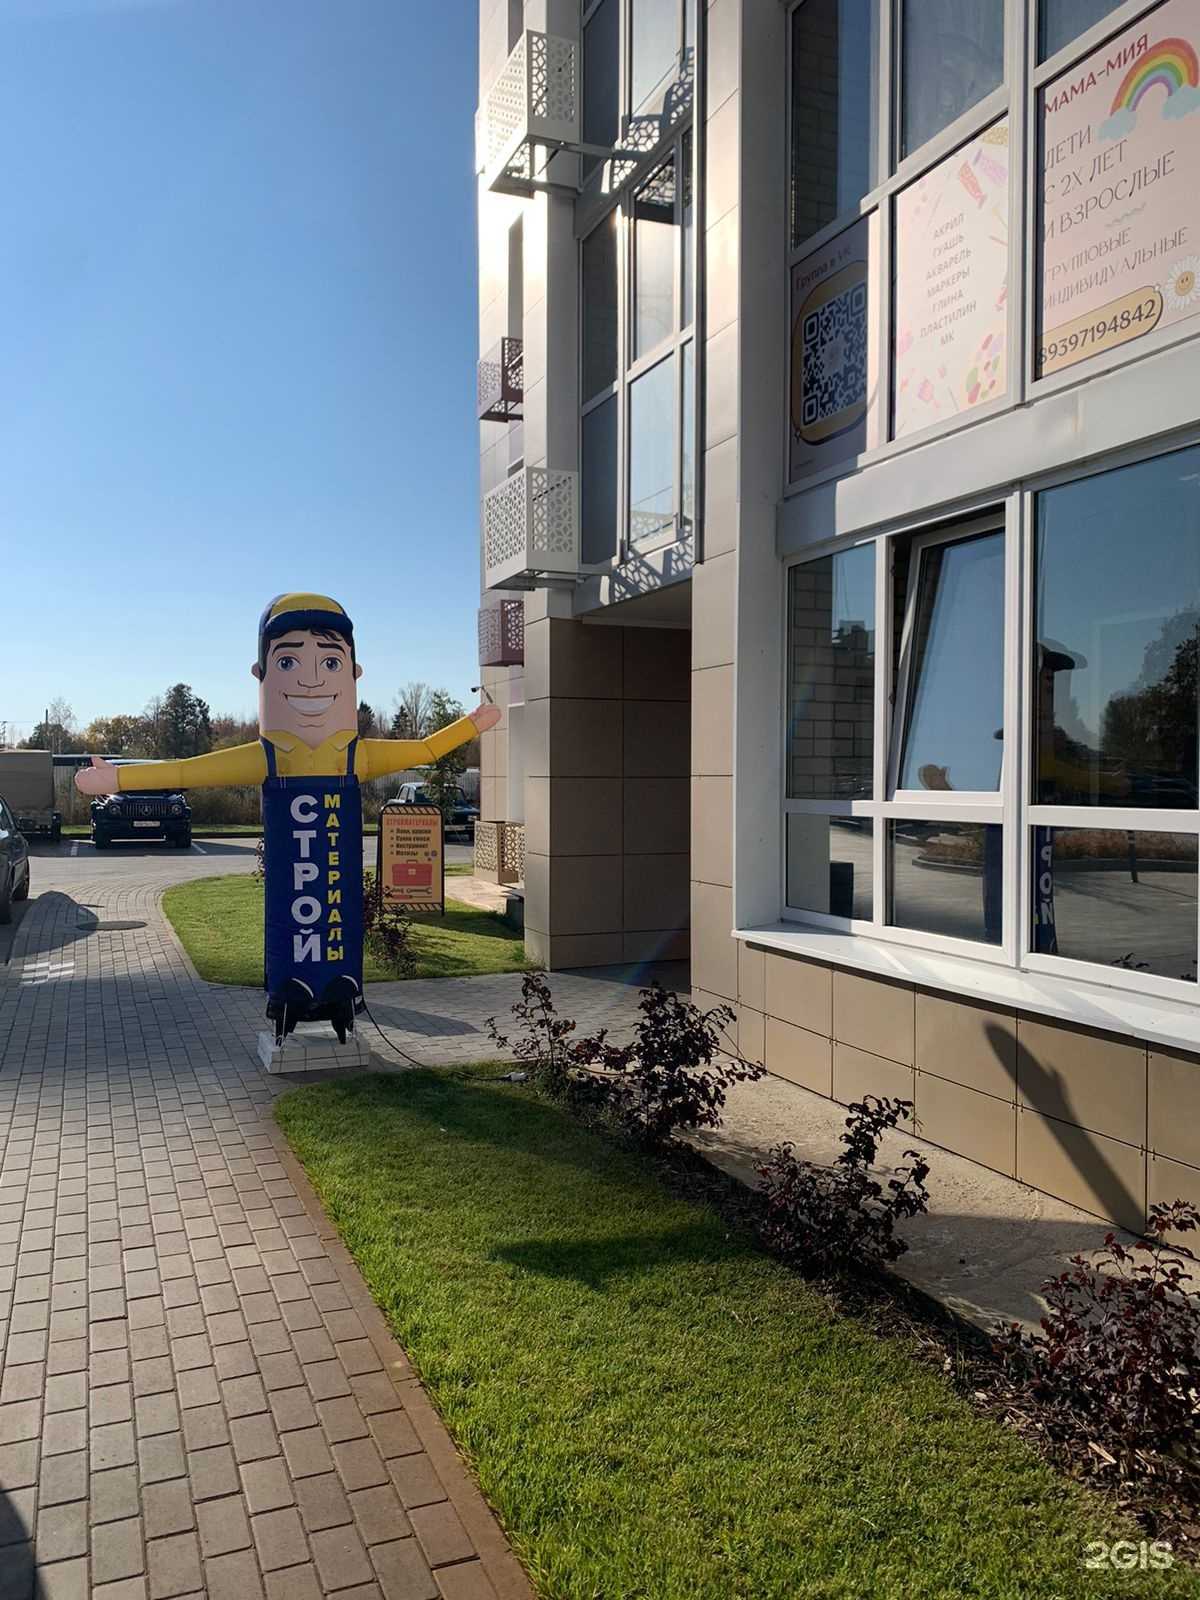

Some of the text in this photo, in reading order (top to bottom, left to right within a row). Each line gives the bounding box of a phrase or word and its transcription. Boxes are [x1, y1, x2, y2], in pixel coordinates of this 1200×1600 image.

[1045, 33, 1148, 113] МАМА-МИЯ
[1045, 124, 1091, 169] ДЕТИ
[1089, 139, 1127, 182] ЛЕТ
[1060, 150, 1175, 233] ВЗРОСЛЫЕ
[934, 212, 964, 239] АКРИЛ
[926, 247, 972, 280] АКВАРЕЛЬ
[927, 265, 970, 298] МАРКЕРЫ
[920, 300, 977, 338] ПЛАСТИЛИН
[932, 289, 964, 313] ГЛИНА
[290, 794, 322, 963] СТРОЙ
[324, 794, 343, 961] МАТЕРИАЛЫ
